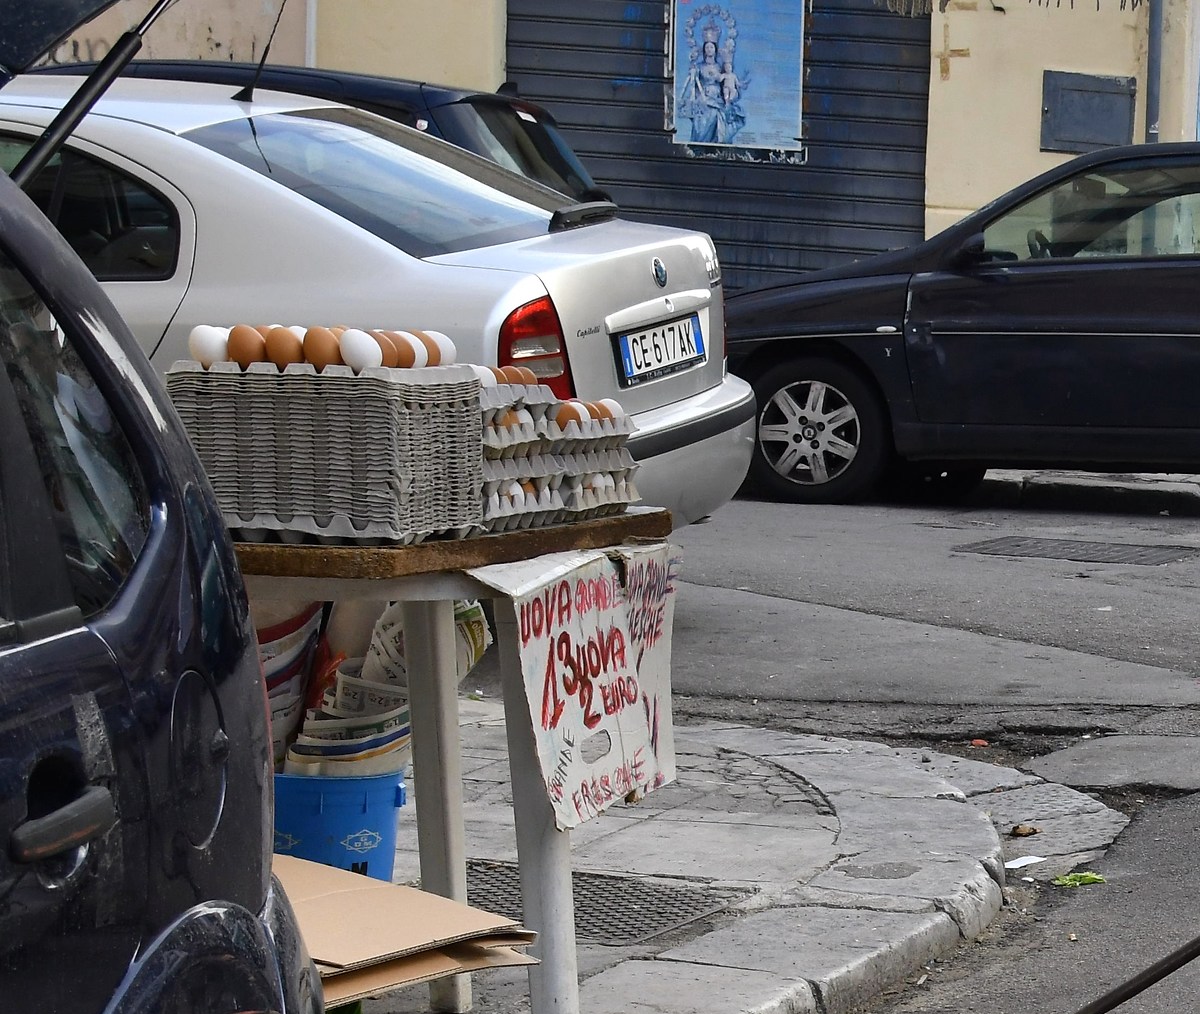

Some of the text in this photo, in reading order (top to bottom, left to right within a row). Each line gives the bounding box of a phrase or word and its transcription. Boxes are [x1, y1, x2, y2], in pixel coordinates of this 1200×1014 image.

[520, 579, 572, 648] UOVA
[579, 675, 639, 729] 2 EURO
